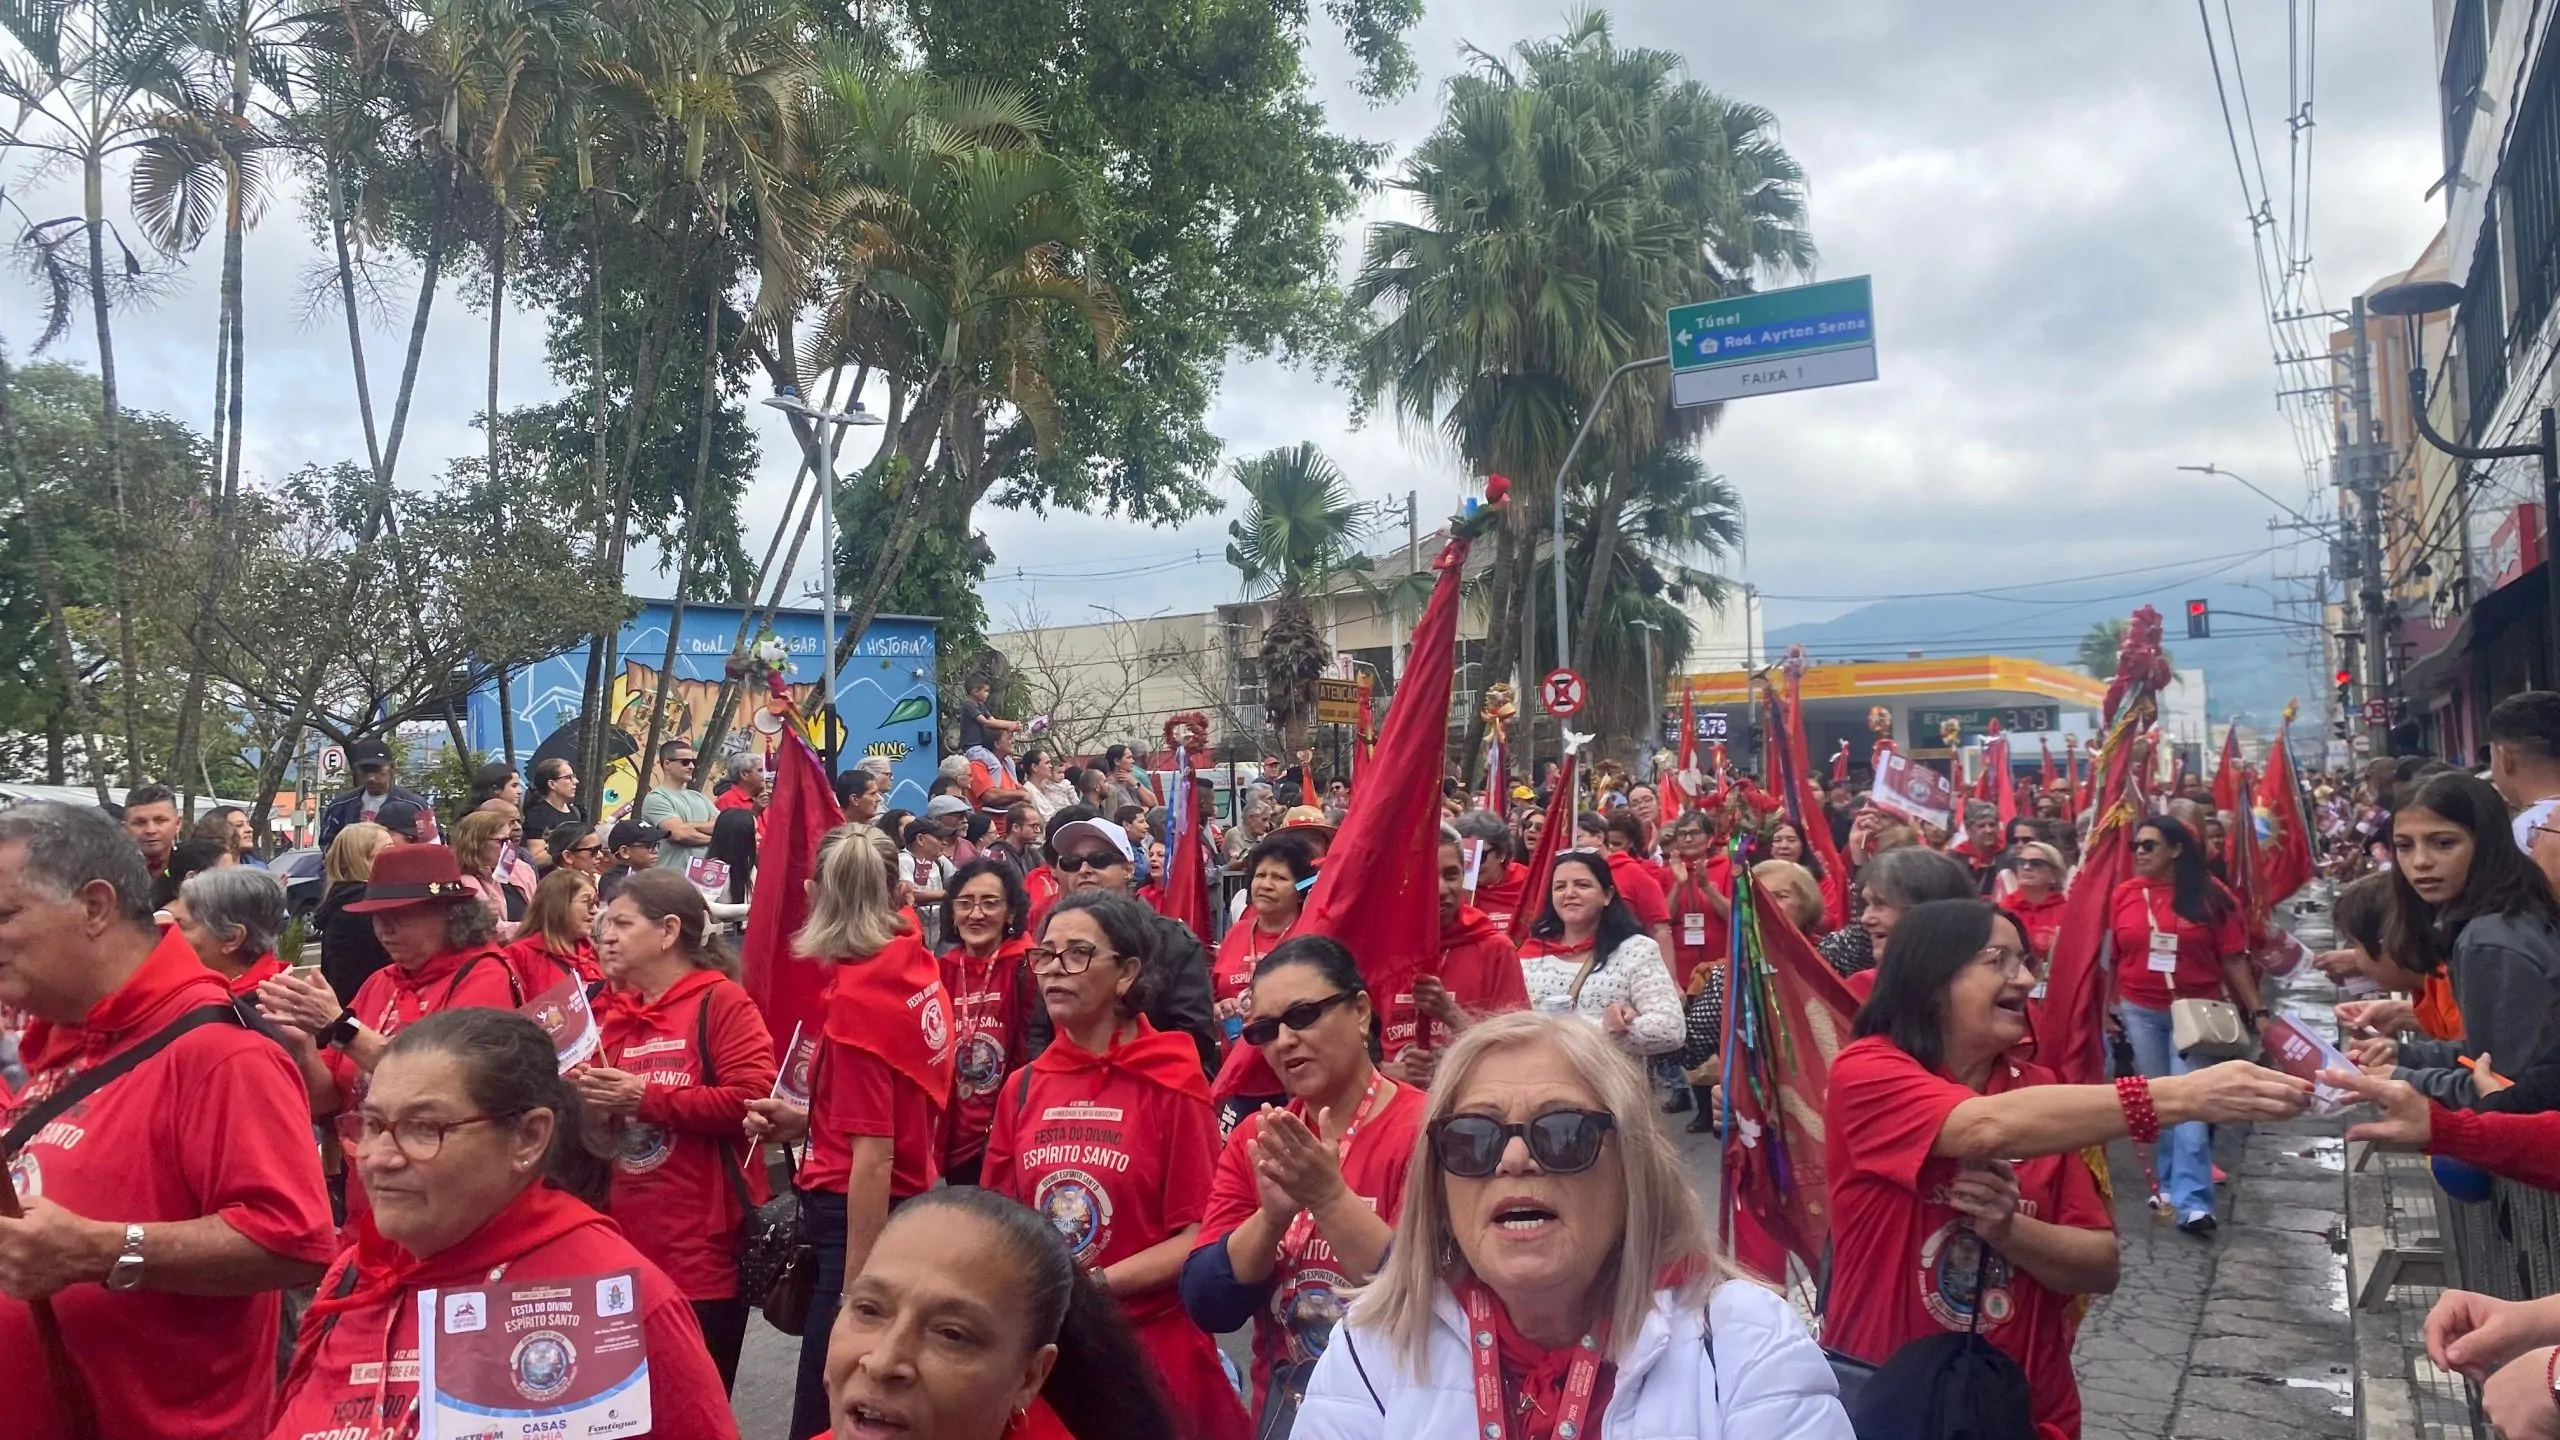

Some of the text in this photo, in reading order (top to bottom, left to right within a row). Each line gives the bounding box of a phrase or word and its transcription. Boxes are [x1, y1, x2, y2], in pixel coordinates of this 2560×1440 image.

[1696, 312, 1740, 329] Túnel
[1725, 333, 1756, 348] Rod.
[1761, 326, 1814, 344] Ayrton
[1818, 318, 1866, 335] Senna
[1742, 367, 1803, 387] FAIXA 1
[329, 753, 337, 767] E
[652, 1071, 691, 1086] SANTO
[1035, 1126, 1124, 1146] FESTA DO DIVINO
[1023, 1143, 1130, 1173] ESPÍRITO SANTO
[1082, 1176, 1100, 1192] SANTO
[511, 1301, 573, 1317] FESTA DO DIVINO
[505, 1313, 580, 1333] ESPÍRITO SANTO
[522, 1420, 568, 1434] CASAS
